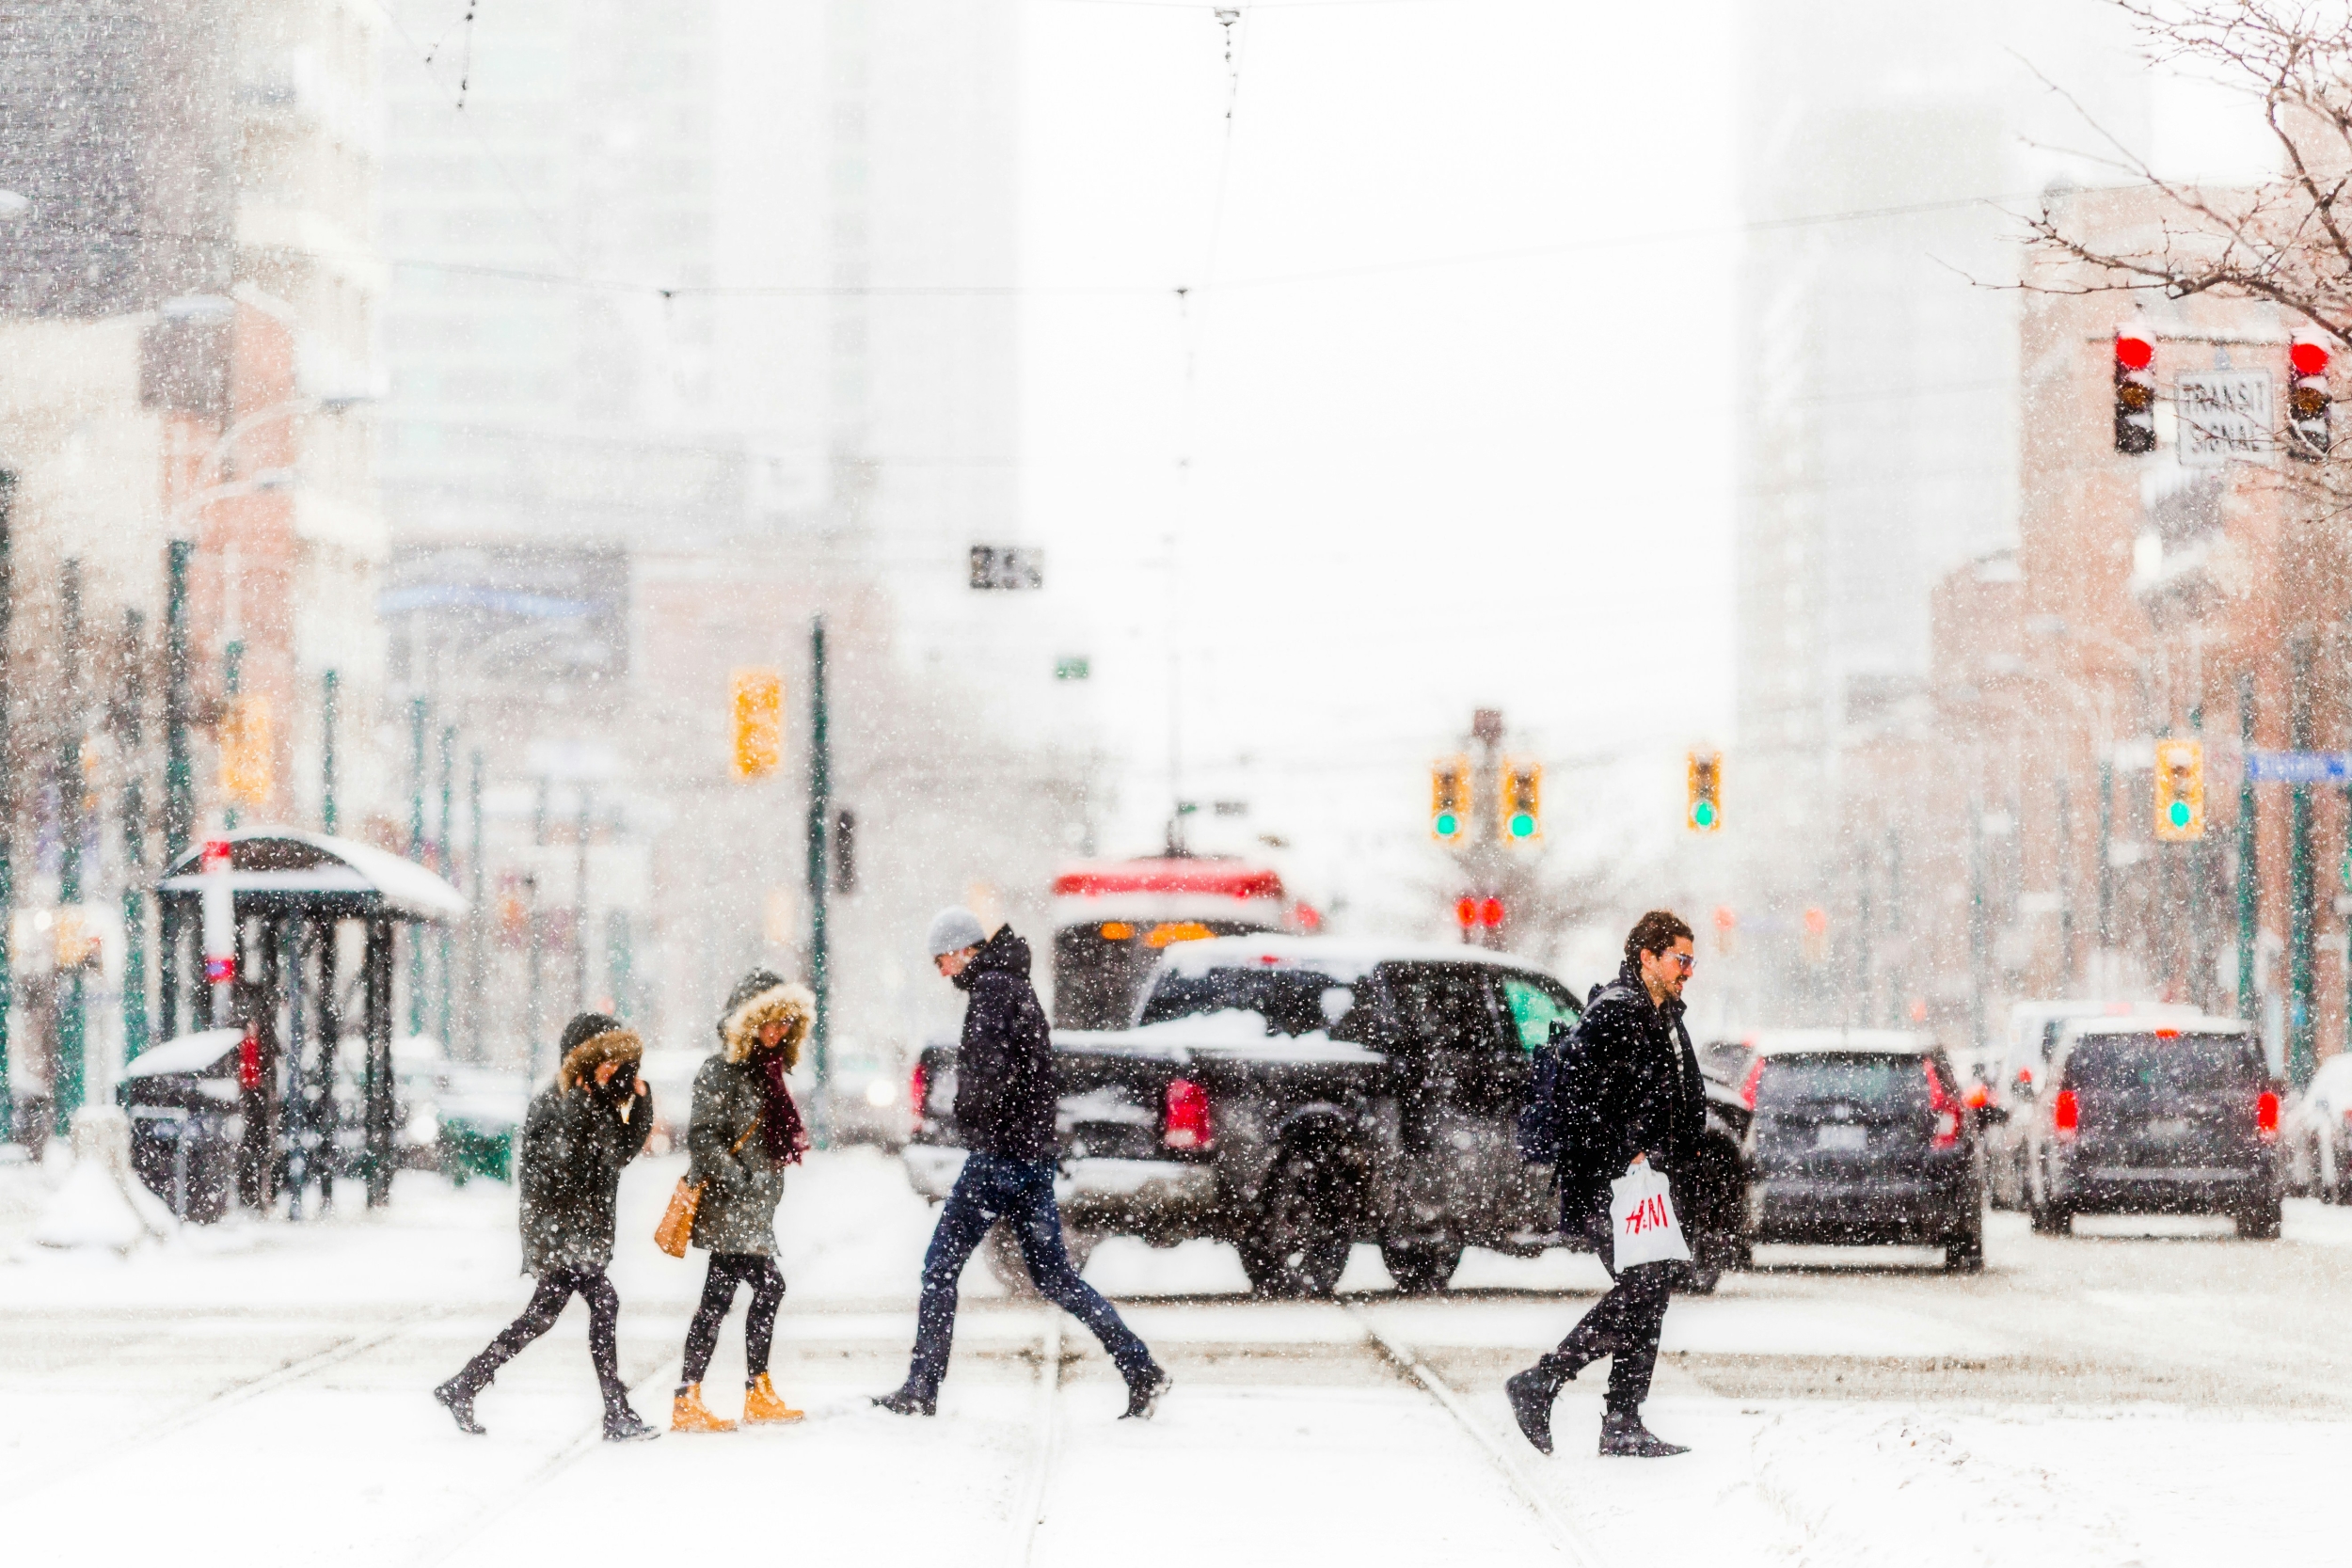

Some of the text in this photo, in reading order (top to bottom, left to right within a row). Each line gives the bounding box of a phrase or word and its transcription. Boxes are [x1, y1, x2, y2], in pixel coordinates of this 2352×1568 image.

[2182, 381, 2264, 413] TRANSIT
[2189, 423, 2260, 453] SIGNAL
[1625, 1194, 1668, 1235] H&M
